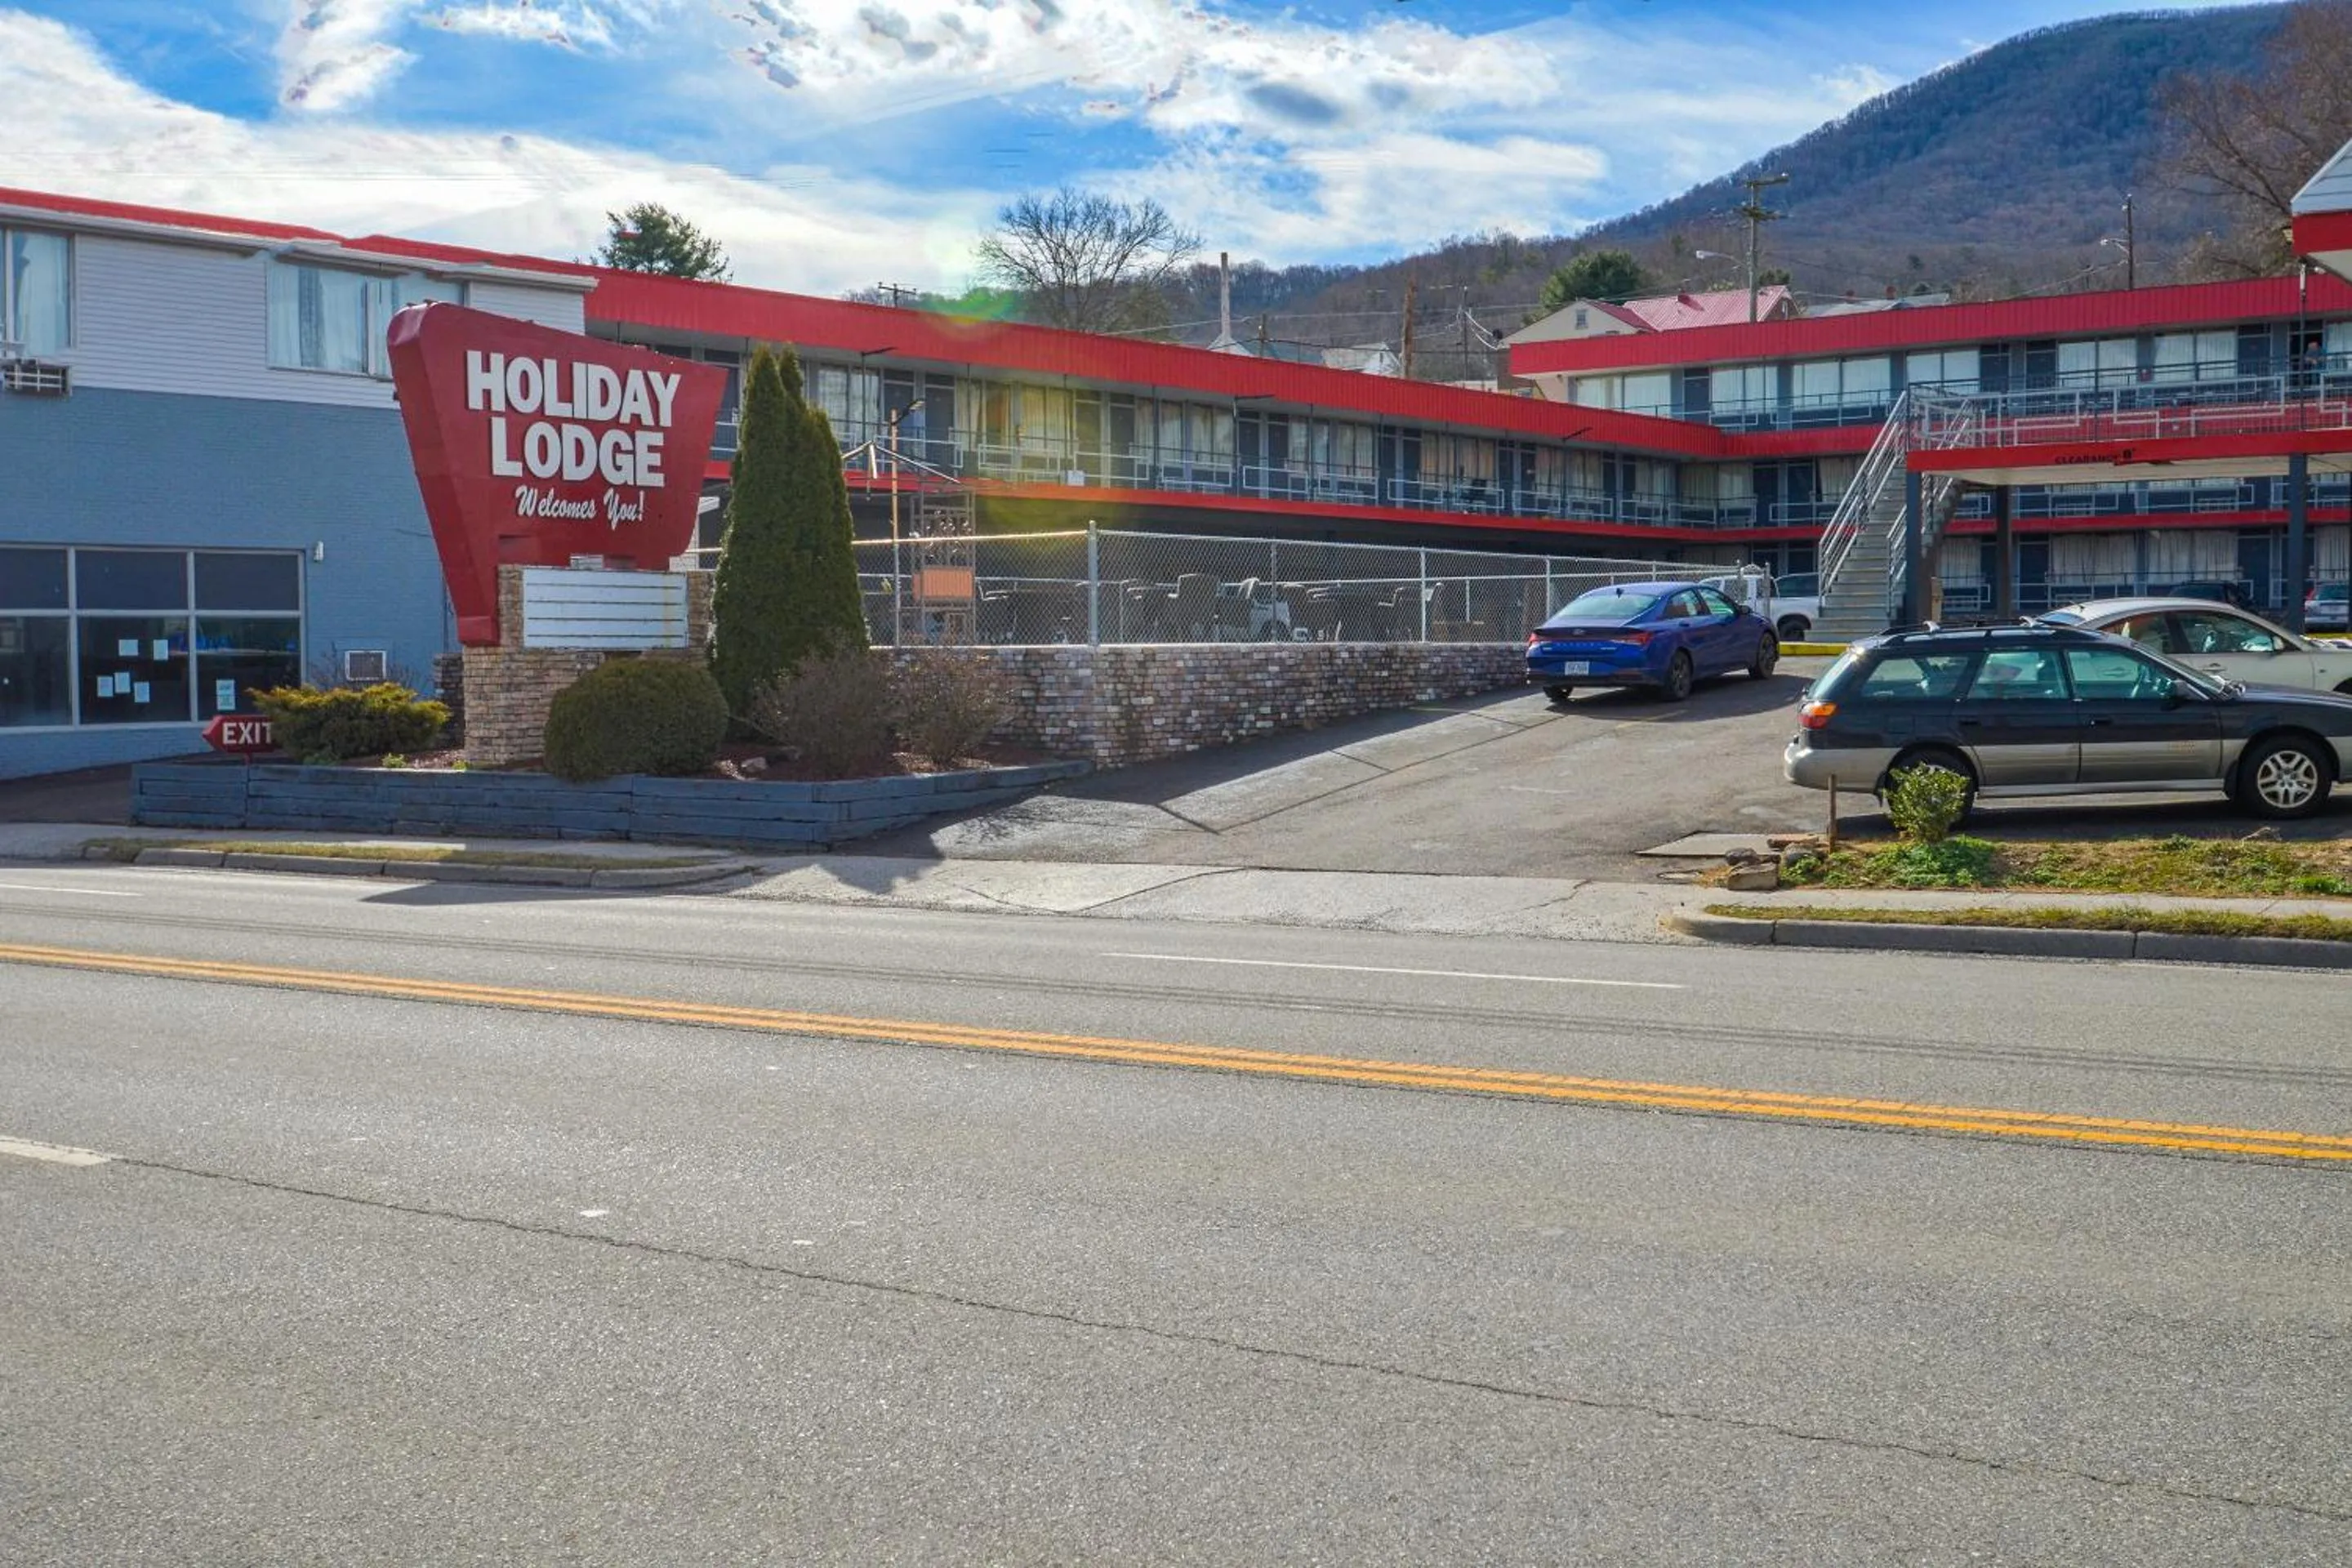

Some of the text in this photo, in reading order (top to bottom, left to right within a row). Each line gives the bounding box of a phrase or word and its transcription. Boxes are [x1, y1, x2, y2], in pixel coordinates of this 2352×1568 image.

[466, 350, 681, 427] HOLIDAY
[492, 416, 665, 488] LODGE
[515, 485, 644, 531] Welcomes You!
[222, 722, 274, 744] EXIT
